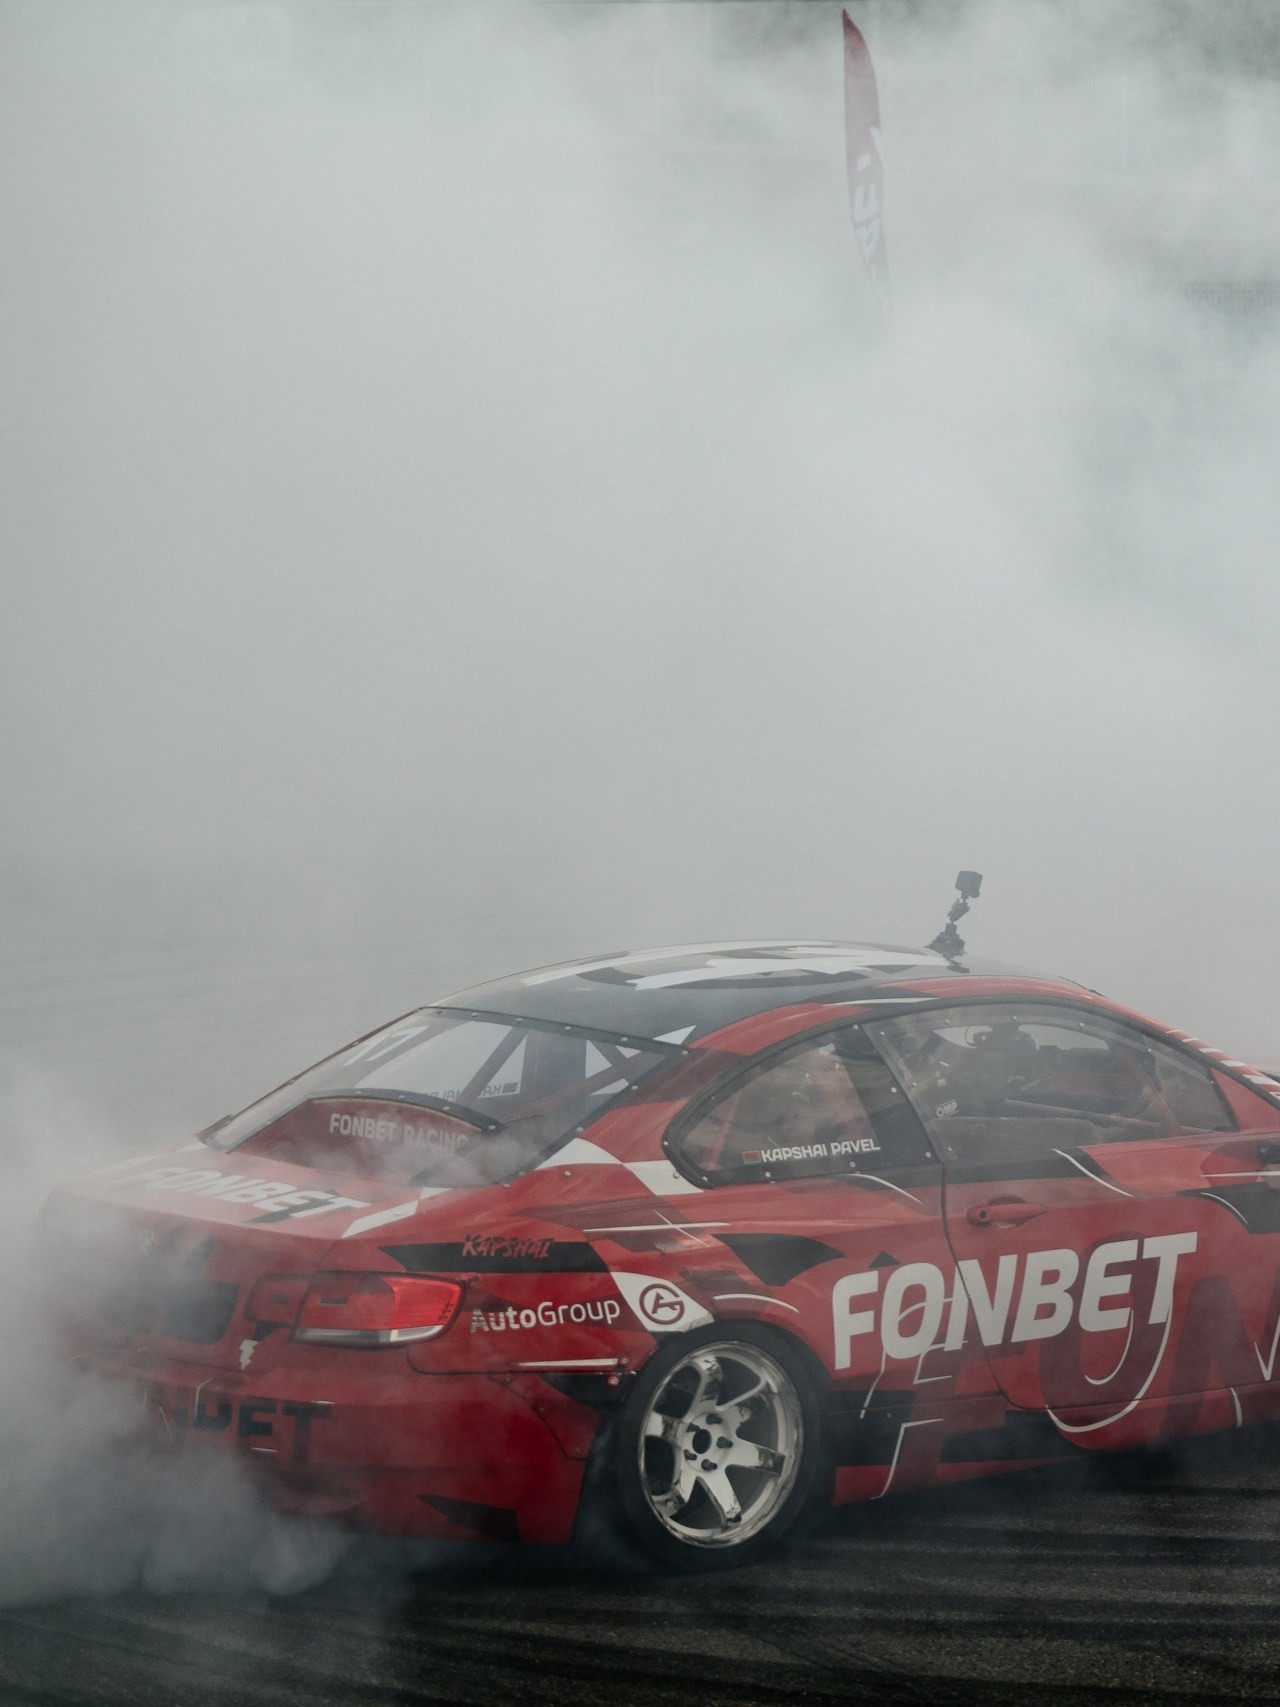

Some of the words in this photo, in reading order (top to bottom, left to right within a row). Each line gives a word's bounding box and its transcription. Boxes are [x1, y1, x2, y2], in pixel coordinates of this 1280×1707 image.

[936, 1101, 958, 1117] OMP
[330, 1113, 397, 1142] FONBET
[404, 1124, 468, 1149] RACING
[761, 1145, 828, 1162] KAPSHAI
[830, 1138, 881, 1155] PAVEL
[111, 1167, 372, 1218] FONBET
[462, 1234, 554, 1258] KAPSHAI
[470, 1300, 621, 1333] AutoGroup
[832, 1231, 1198, 1370] FONBET
